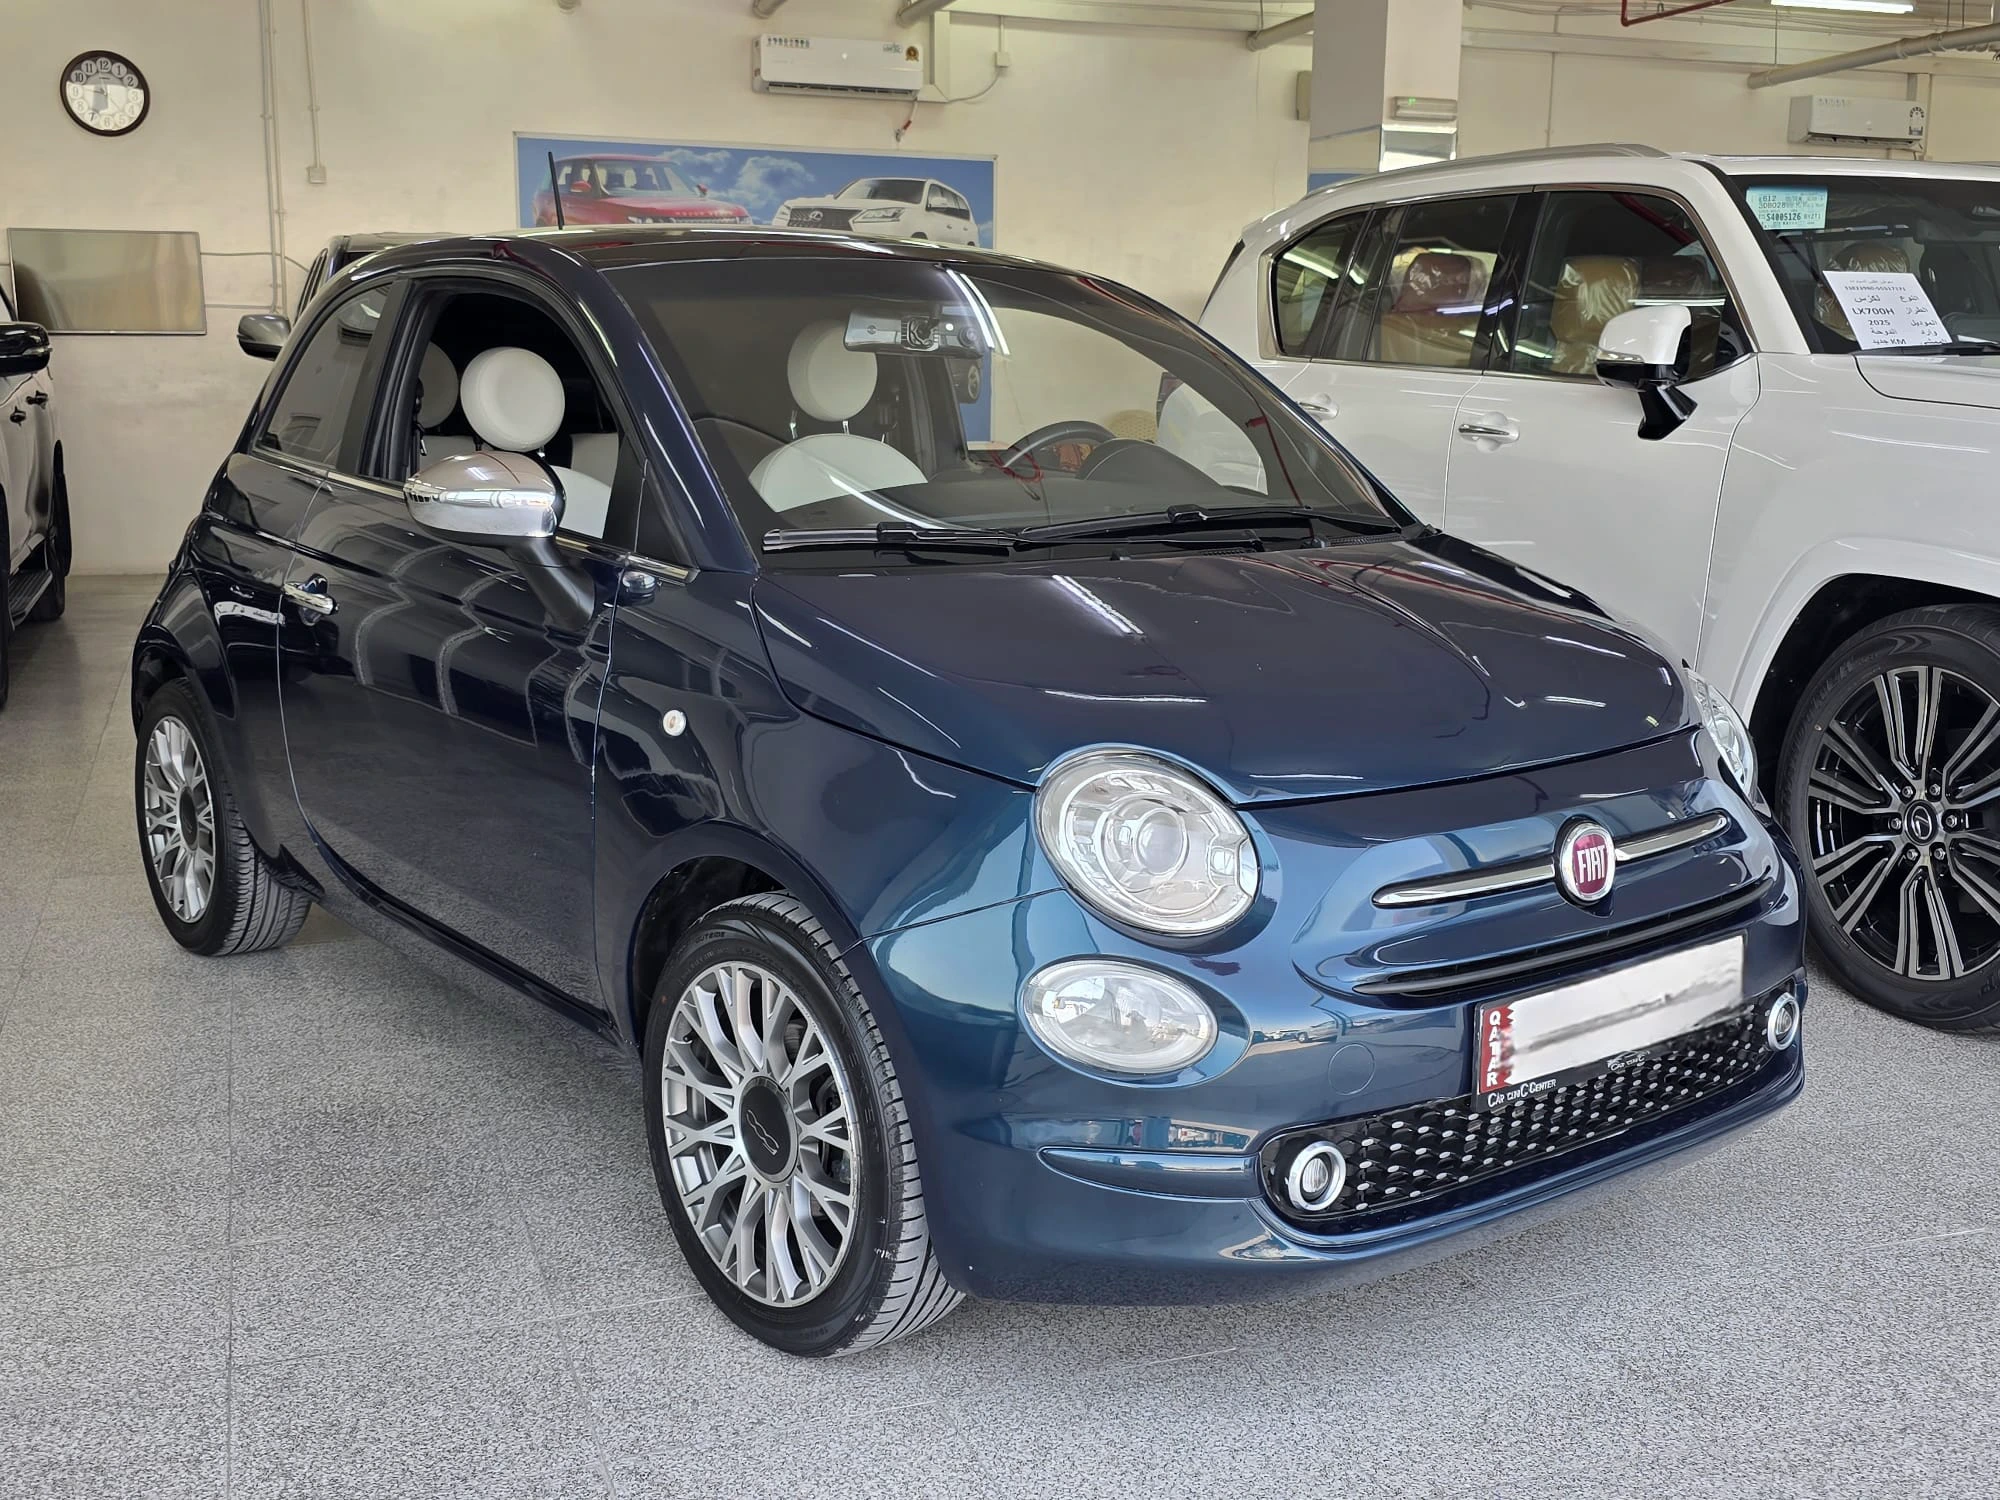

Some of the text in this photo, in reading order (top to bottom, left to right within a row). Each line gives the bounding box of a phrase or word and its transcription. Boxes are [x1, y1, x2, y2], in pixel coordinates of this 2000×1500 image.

[86, 63, 93, 73] 11
[99, 60, 109, 70] 12
[75, 72, 84, 82] 10
[127, 76, 134, 87] 2
[88, 112, 95, 121] 7
[1852, 307, 1895, 315] LX700H
[1576, 844, 1606, 884] FIAT
[1486, 1010, 1502, 1088] QATAR
[1529, 1079, 1557, 1094] CENTER
